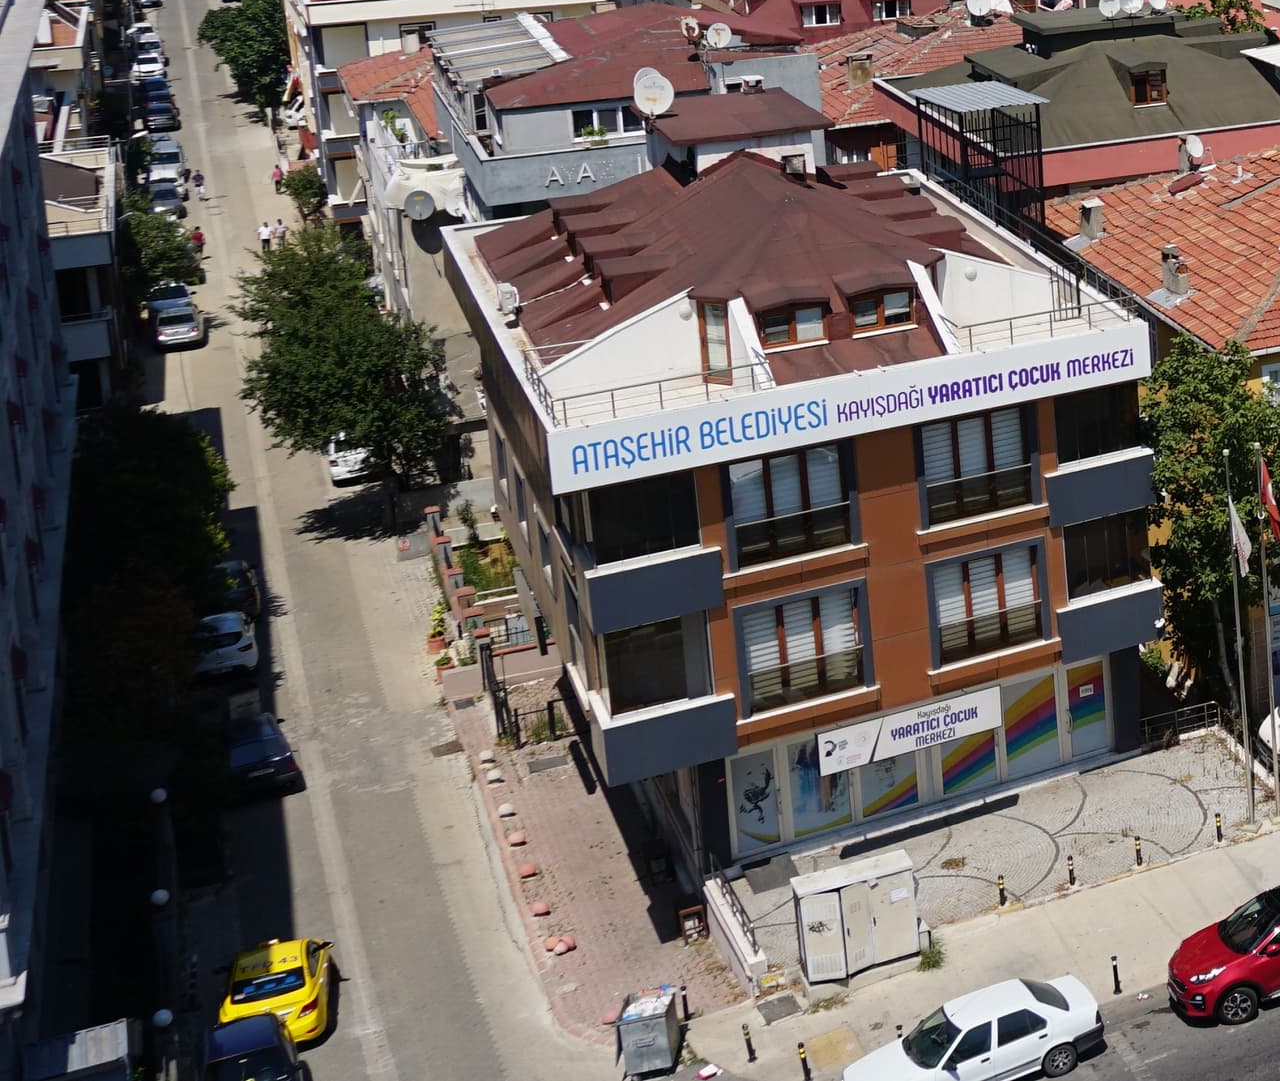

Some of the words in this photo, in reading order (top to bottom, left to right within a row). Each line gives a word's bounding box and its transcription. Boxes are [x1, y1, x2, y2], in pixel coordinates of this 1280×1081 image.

[571, 424, 693, 475] ATAŞEHİR
[699, 398, 829, 451] BELEDİYESİ
[836, 385, 924, 424] KAYIŞDAĞI
[927, 372, 1004, 406] YARATICI
[1008, 361, 1062, 392] ÇOCUK
[1066, 348, 1135, 379] MERKEZİ
[890, 716, 940, 741] YARATICI
[943, 706, 978, 728] ÇOCUK
